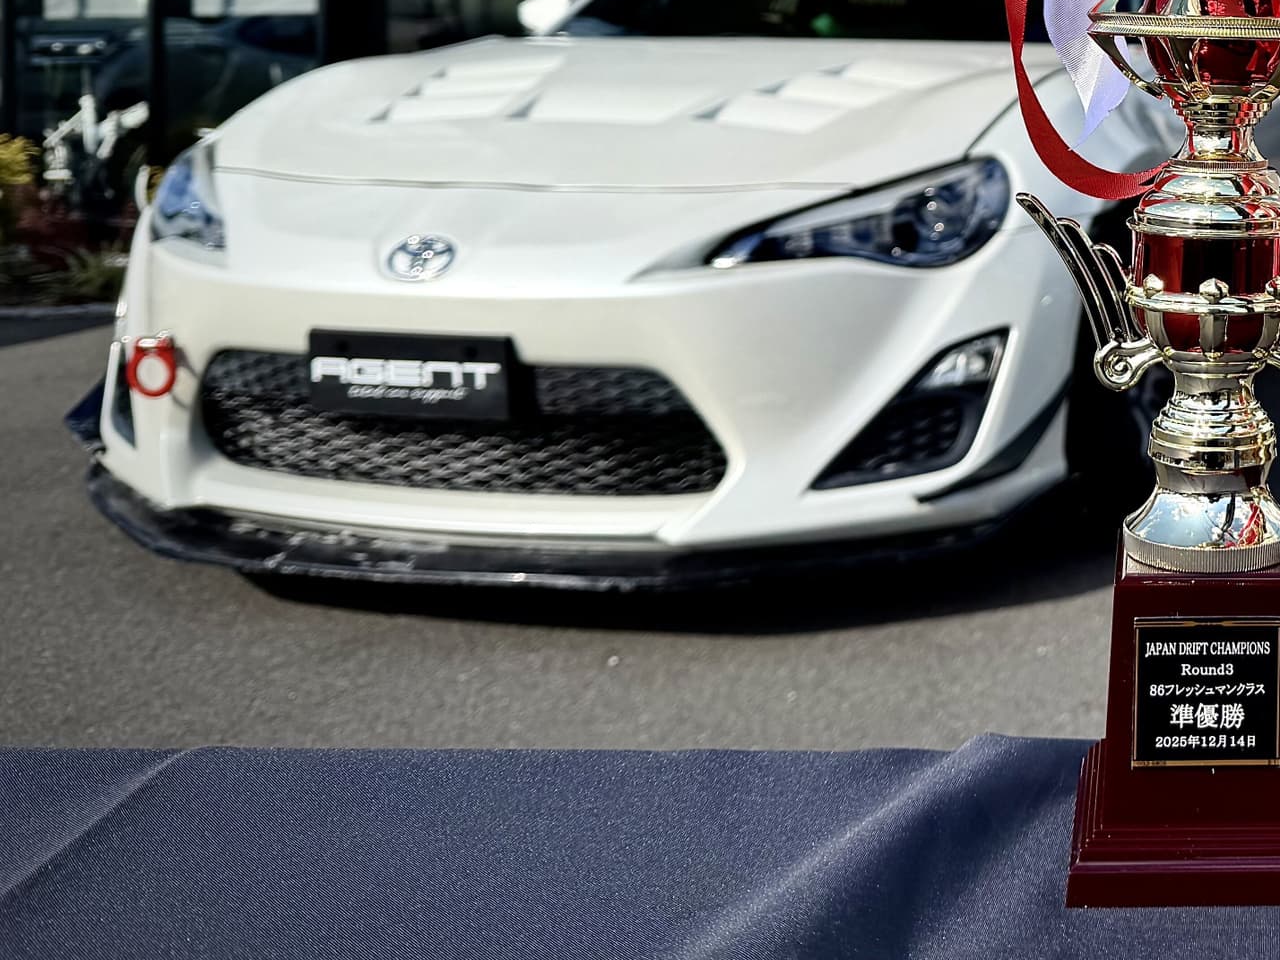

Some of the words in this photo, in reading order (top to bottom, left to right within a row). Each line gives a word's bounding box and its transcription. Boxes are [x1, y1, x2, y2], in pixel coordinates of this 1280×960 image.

[311, 357, 501, 390] AGENT
[1145, 642, 1177, 657] JAPAN
[1179, 642, 1209, 656] DRIFT
[1210, 641, 1271, 656] CHAMPIONS
[1180, 664, 1234, 676] Round3
[1149, 683, 1266, 697] 86フレッシュマンクラス
[1169, 702, 1246, 729] 準優勝
[1155, 735, 1256, 748] 2025年12月14日
